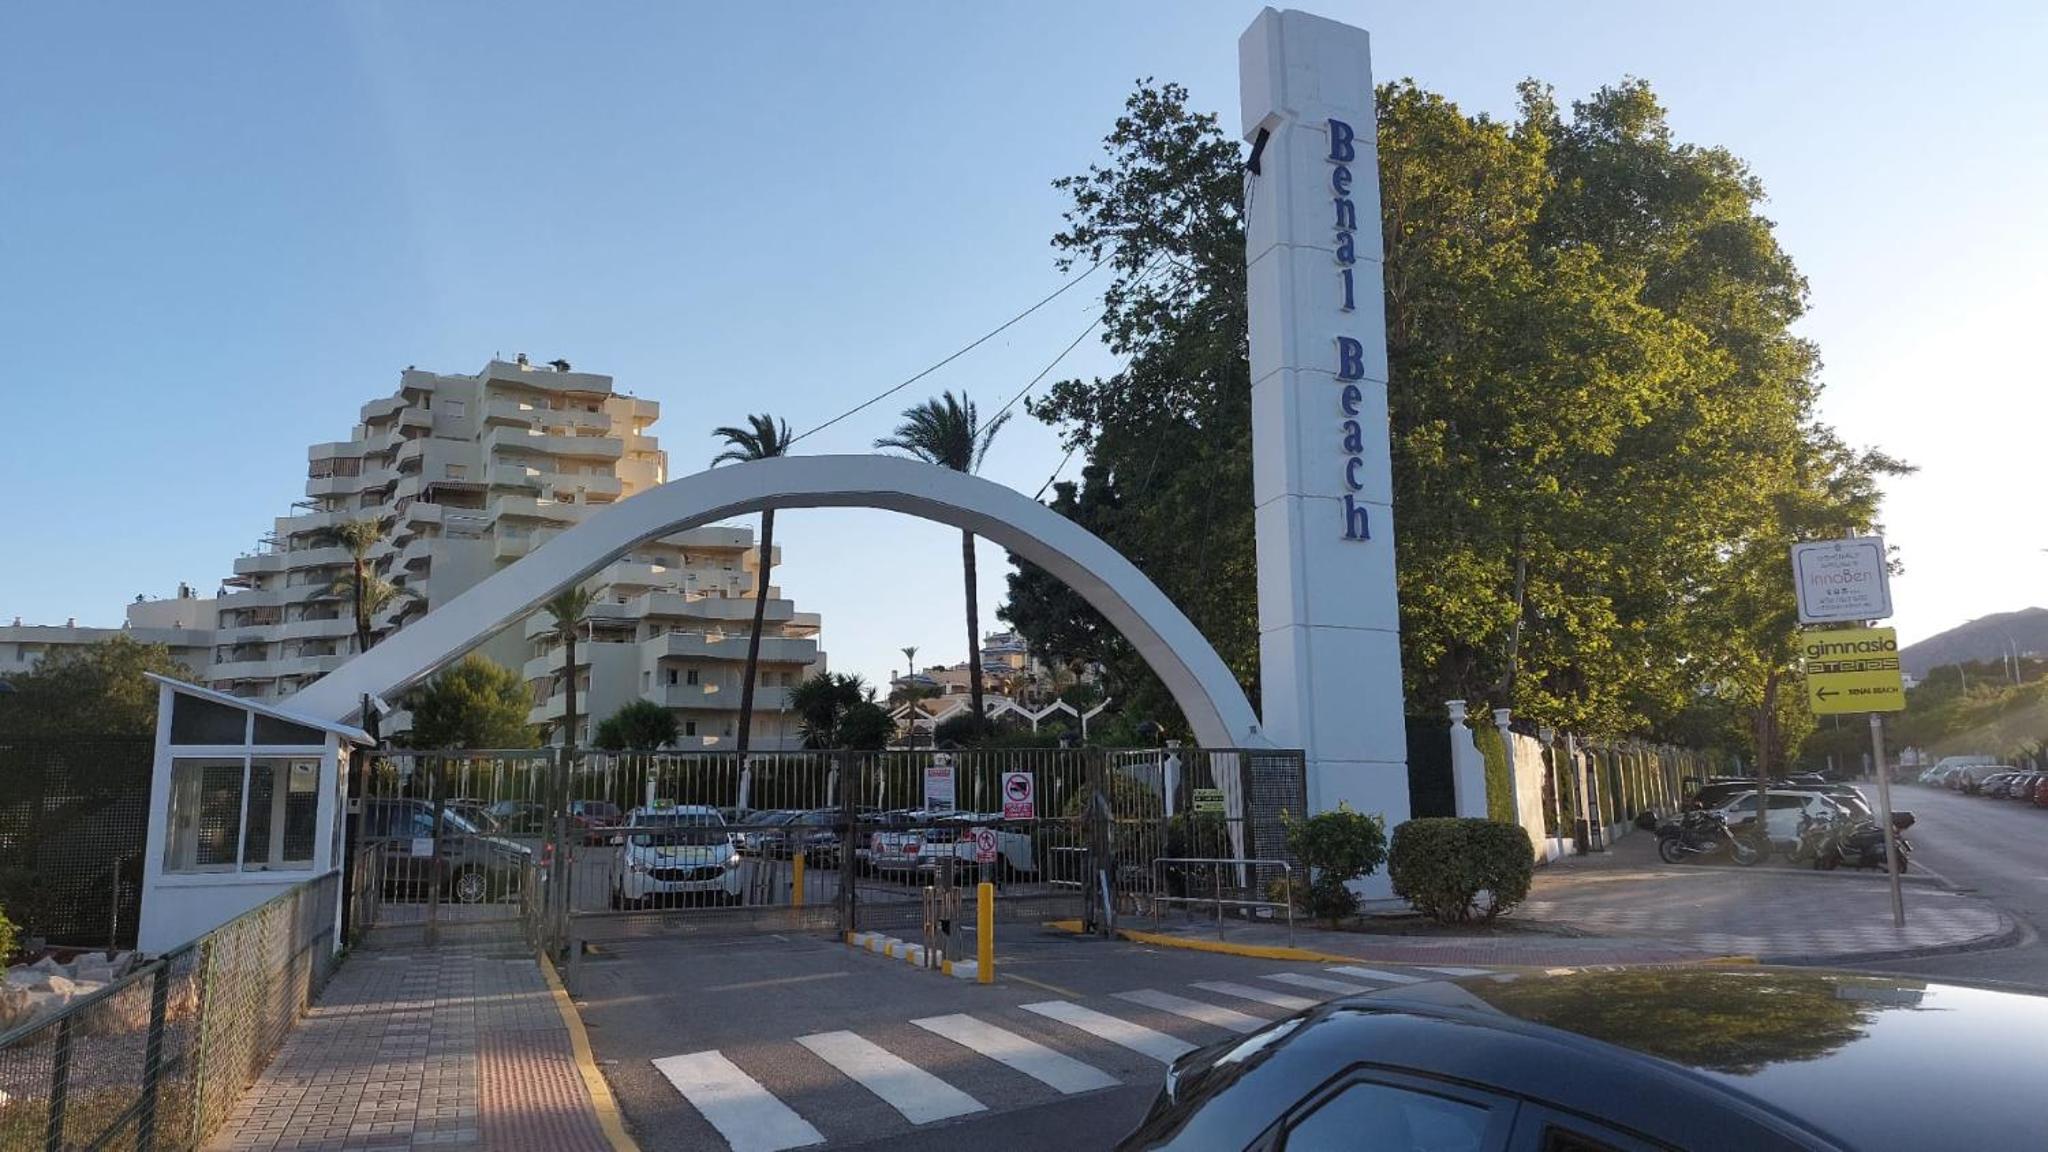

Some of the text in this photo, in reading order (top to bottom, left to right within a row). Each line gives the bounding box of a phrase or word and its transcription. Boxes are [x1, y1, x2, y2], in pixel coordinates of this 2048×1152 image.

[1328, 118, 1371, 541] Benal Beach
[1807, 638, 1897, 659] gimnasio
[1873, 687, 1899, 695] BEACH
